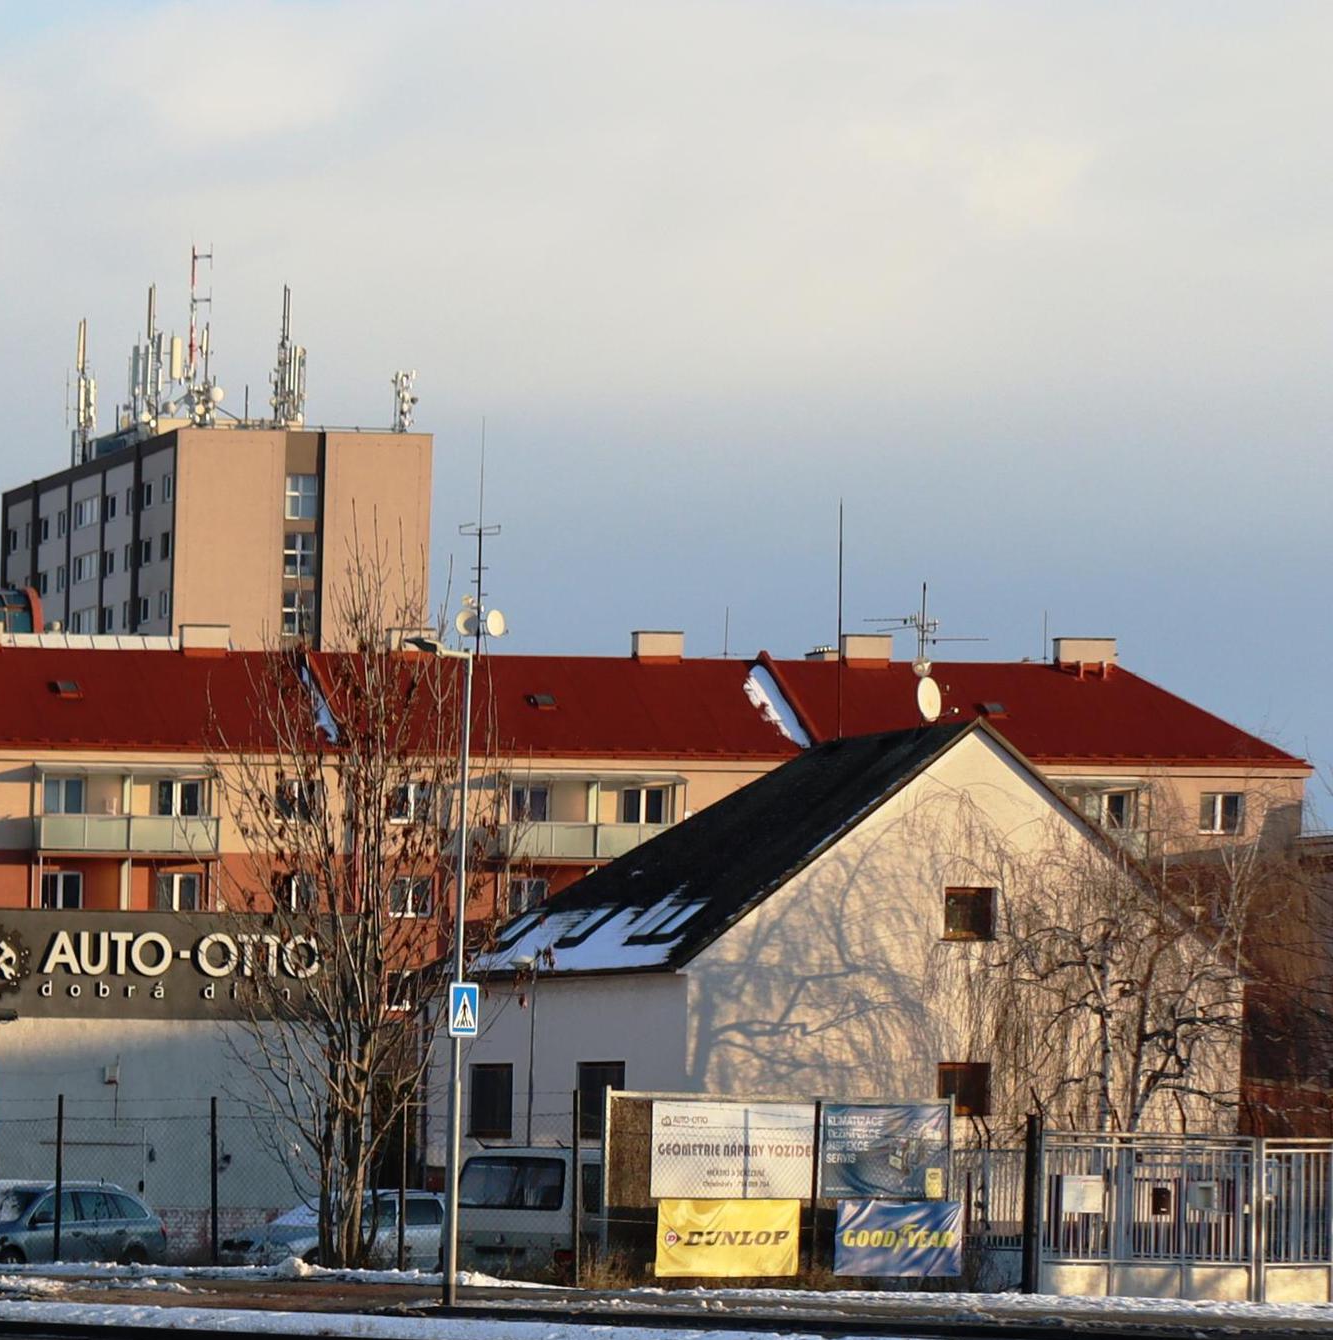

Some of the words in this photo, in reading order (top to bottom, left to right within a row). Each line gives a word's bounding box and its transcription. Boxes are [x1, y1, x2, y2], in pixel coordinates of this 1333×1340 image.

[42, 930, 320, 979] AUTO-OTTO
[41, 980, 165, 999] dobrá
[657, 1143, 721, 1157] GEOMETRIE
[825, 1152, 857, 1164] SERVIS
[683, 1230, 790, 1247] DUNLOP
